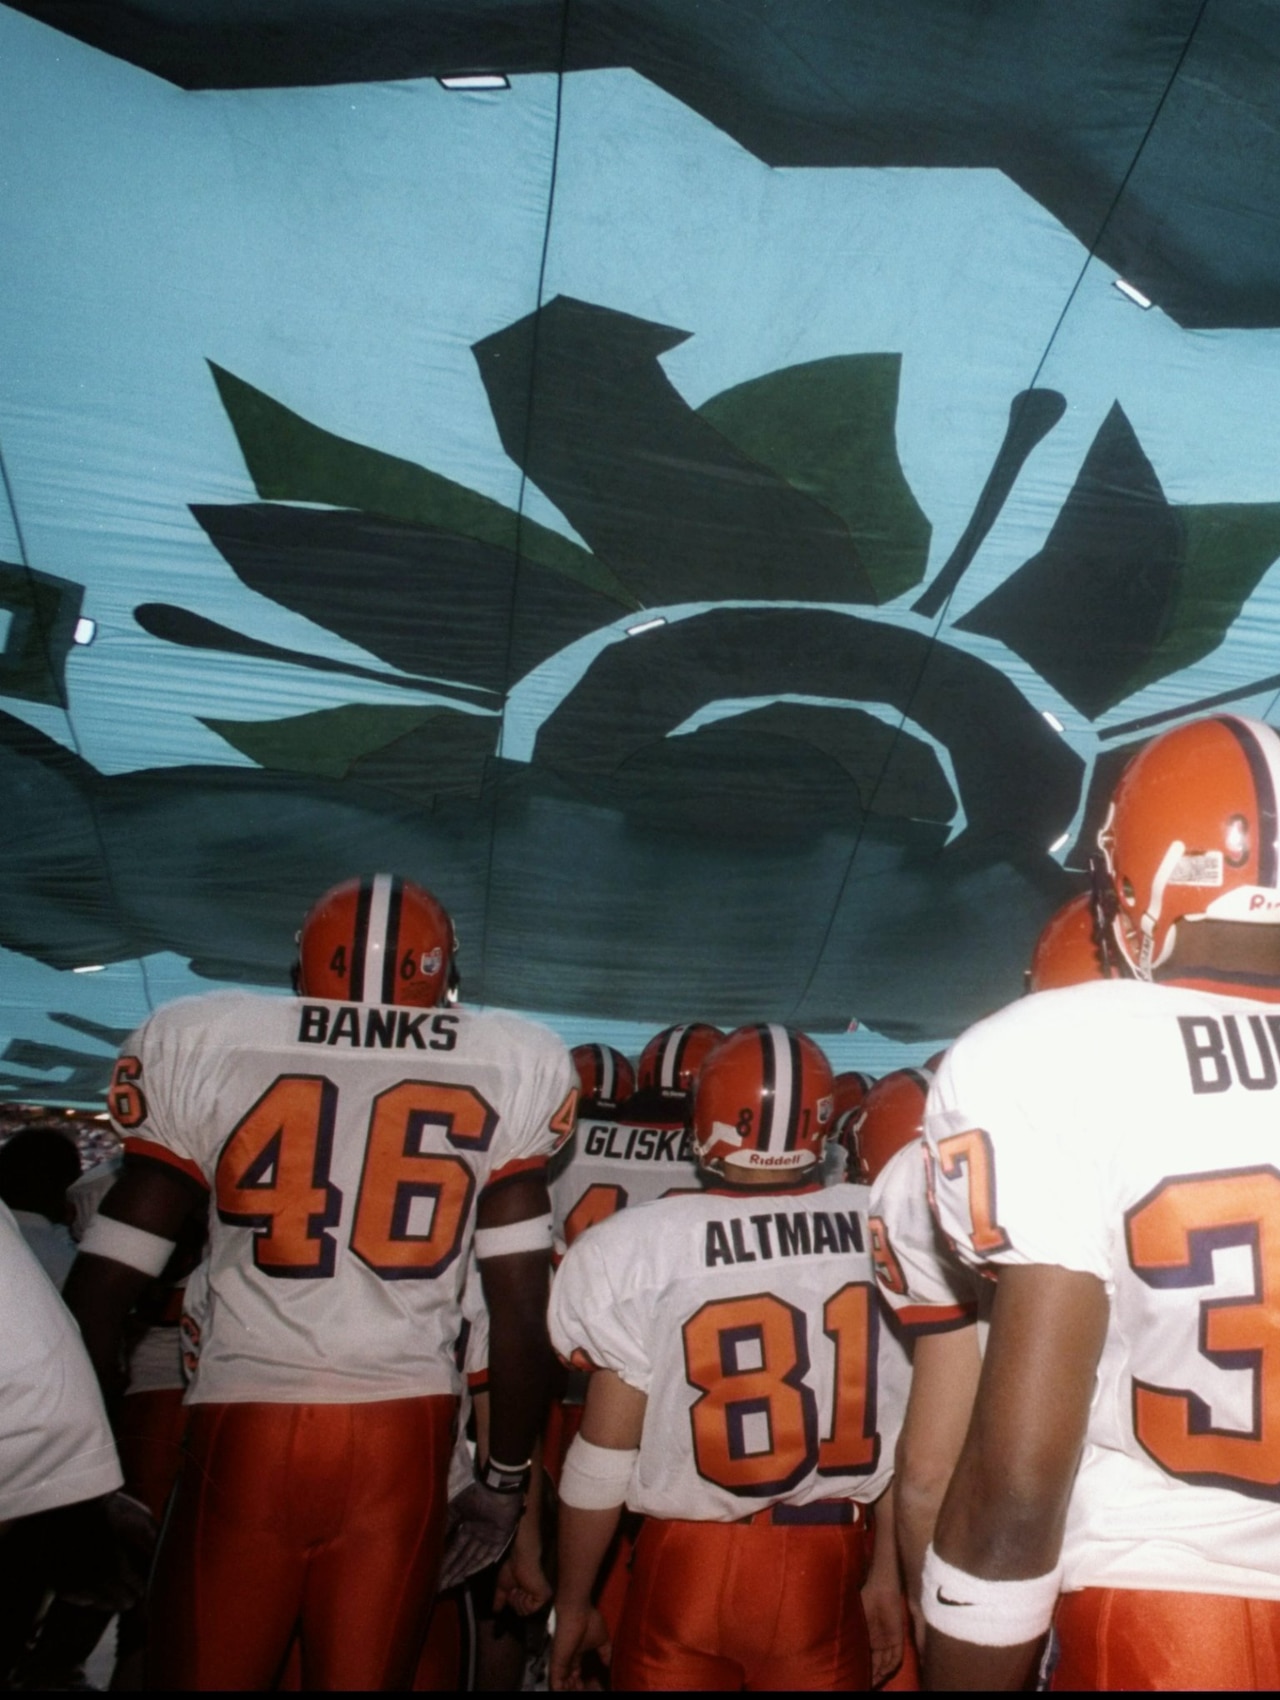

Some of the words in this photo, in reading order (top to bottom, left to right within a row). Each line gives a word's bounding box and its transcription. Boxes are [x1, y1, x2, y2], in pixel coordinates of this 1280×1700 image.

[329, 944, 348, 979] 4
[400, 949, 417, 981] 6
[297, 1004, 460, 1052] BANKS
[107, 1055, 149, 1129] 6
[735, 1107, 754, 1138] 8
[802, 1108, 811, 1140] 1
[215, 1072, 501, 1282] 46
[749, 1153, 801, 1166] Riddell
[705, 1210, 865, 1268] ALTMAN
[681, 1280, 882, 1498] 81
